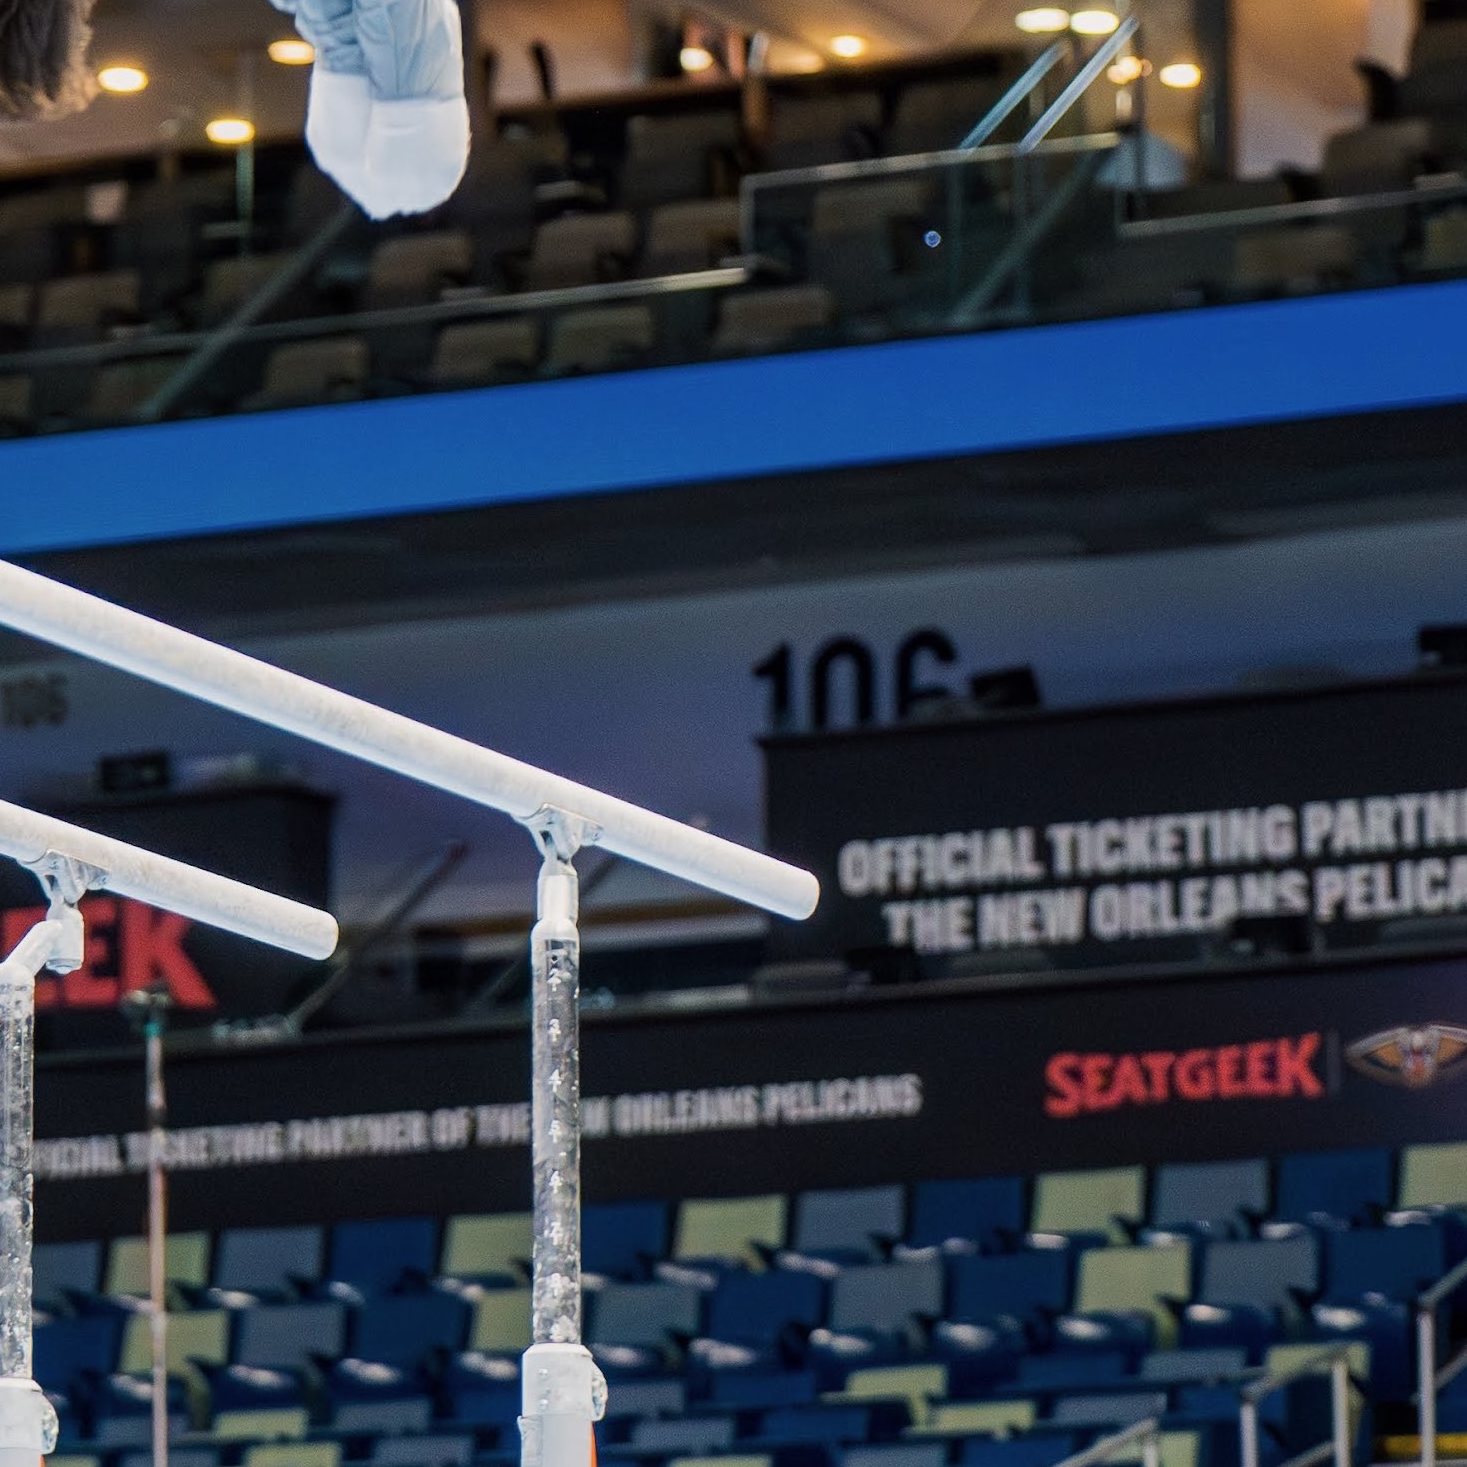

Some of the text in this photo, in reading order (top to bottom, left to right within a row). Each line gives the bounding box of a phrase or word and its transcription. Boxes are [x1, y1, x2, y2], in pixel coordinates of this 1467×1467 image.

[837, 825, 1045, 898] OFFICIAL
[1045, 803, 1298, 879] TICKETING
[881, 895, 975, 956] THE
[977, 887, 1085, 952] NEW
[1087, 868, 1310, 942] ORLEANS
[1043, 1032, 1324, 1119] SEATGEEK
